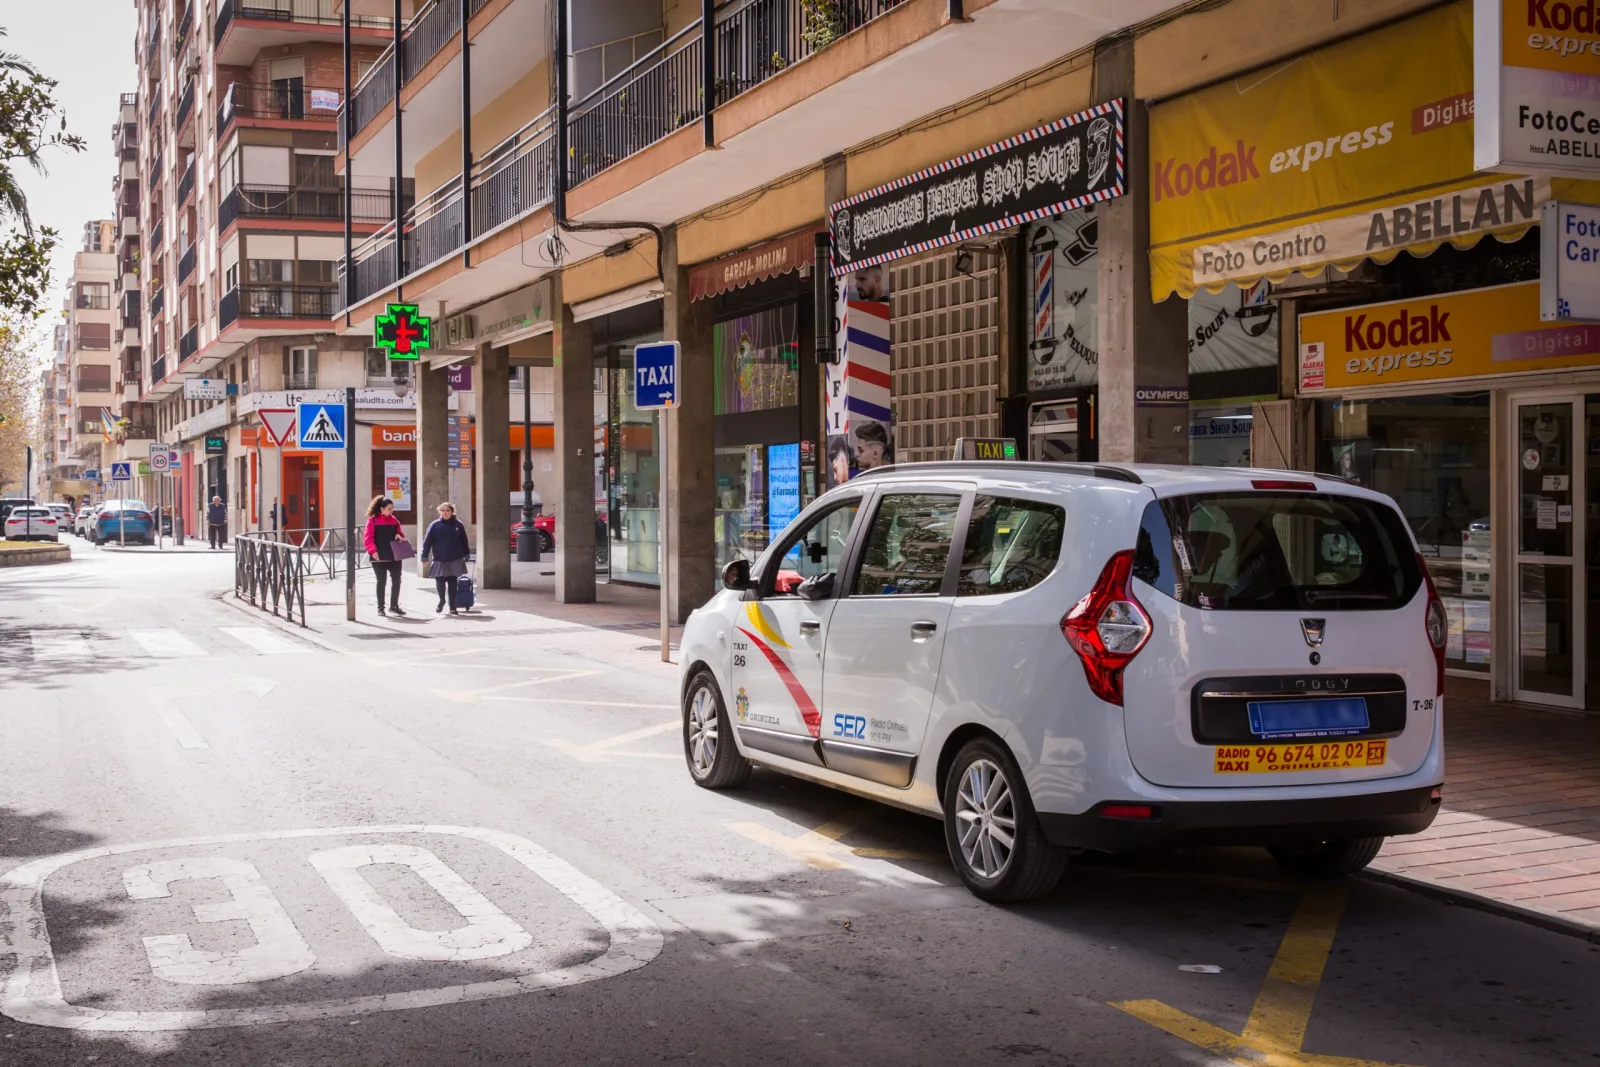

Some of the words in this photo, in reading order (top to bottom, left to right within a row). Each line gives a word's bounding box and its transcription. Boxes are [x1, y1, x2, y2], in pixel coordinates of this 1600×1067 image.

[1154, 139, 1261, 202] Kodak
[1269, 121, 1395, 174] express
[1202, 249, 1246, 276] Foto
[1253, 231, 1327, 267] Centro
[1366, 178, 1535, 252] ABELLAN
[724, 247, 787, 283] GARCIA-MOLINA
[1345, 304, 1451, 353] Kodak
[1345, 347, 1453, 375] express
[1525, 329, 1588, 354] Digital
[638, 365, 674, 388] TAXI
[1136, 390, 1189, 400] OLYMPUS
[976, 442, 1003, 459] TAXI
[733, 642, 748, 650] TAXI
[734, 655, 746, 667] 26
[750, 713, 780, 726] ORIHUELA
[871, 717, 886, 729] Radio
[1217, 748, 1250, 759] RADIO
[1255, 746, 1278, 763] 96
[1283, 745, 1314, 763] 674
[1320, 744, 1340, 760] 02
[1345, 742, 1364, 759] 02
[1370, 748, 1383, 758] 24
[1217, 761, 1250, 772] TAXI
[1267, 760, 1351, 771] ORIHUELA
[121, 843, 533, 986] 30
